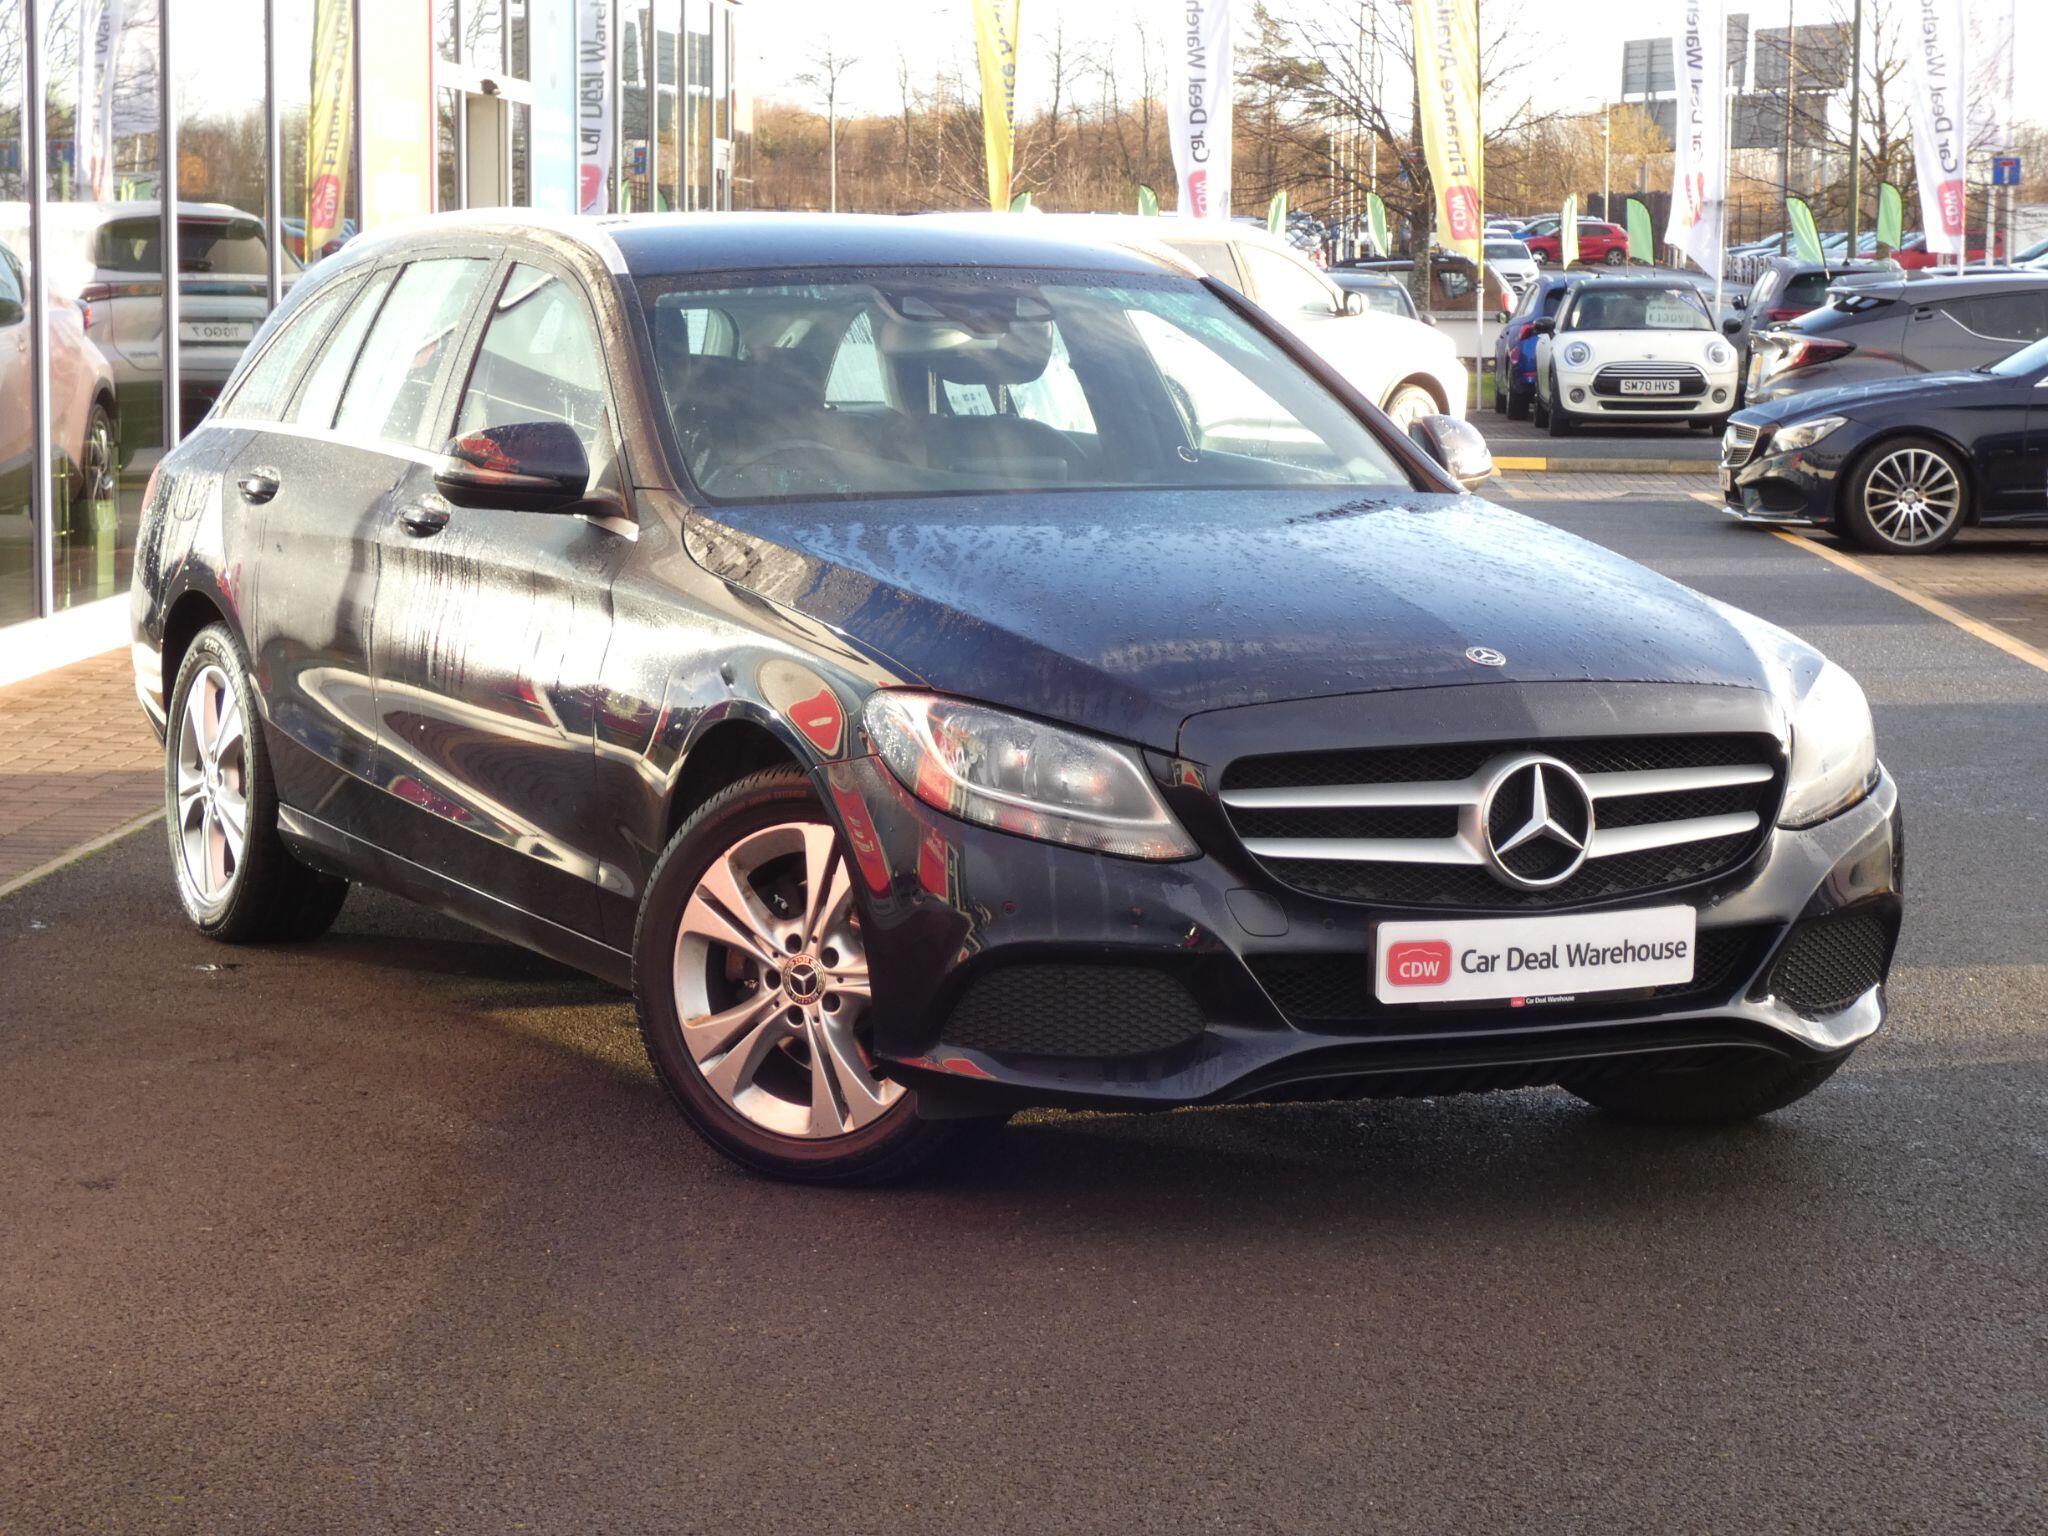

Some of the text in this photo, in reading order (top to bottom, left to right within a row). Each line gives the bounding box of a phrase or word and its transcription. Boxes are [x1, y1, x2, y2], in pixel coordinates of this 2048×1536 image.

[324, 68, 343, 165] Finance
[324, 183, 337, 218] CDW
[1624, 380, 1675, 391] SM70 HVS
[1400, 960, 1440, 977] CDW
[1460, 939, 1687, 974] Car Deal Warehouse
